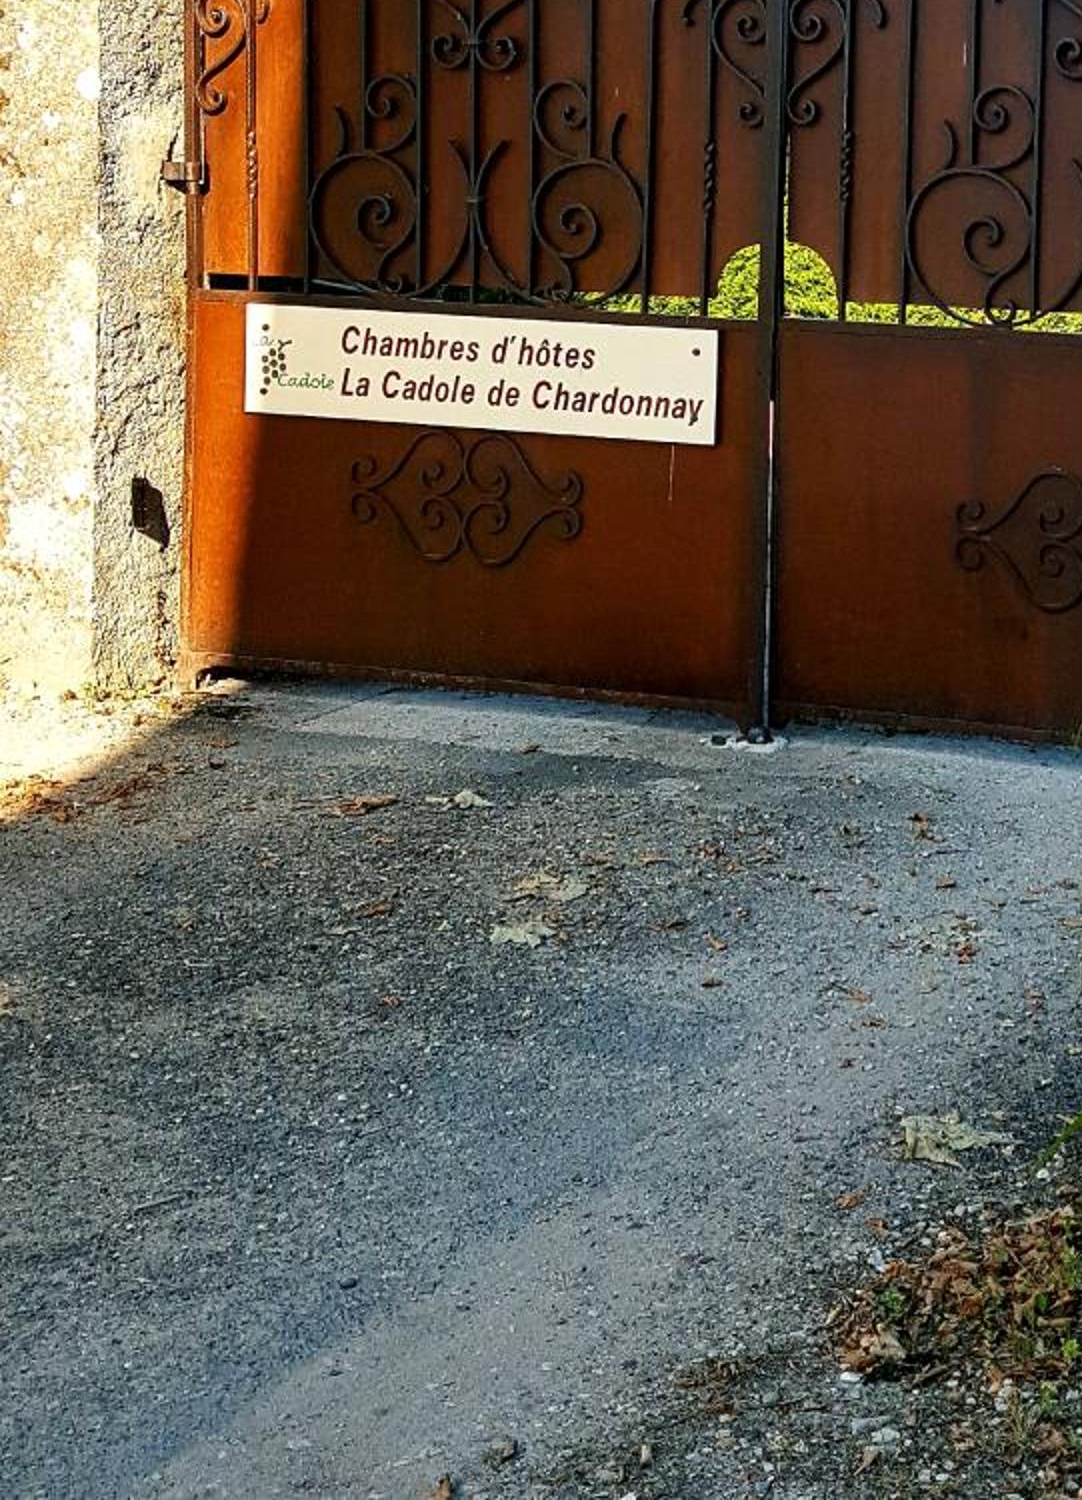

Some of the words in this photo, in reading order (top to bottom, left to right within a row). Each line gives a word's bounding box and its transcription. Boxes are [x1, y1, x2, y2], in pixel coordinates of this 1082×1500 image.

[341, 325, 480, 362] Chambres
[491, 335, 596, 369] d'hôtes
[341, 367, 371, 397] La
[382, 370, 476, 404] Cadole
[487, 379, 521, 407] de
[532, 380, 705, 427] Chardonnay
